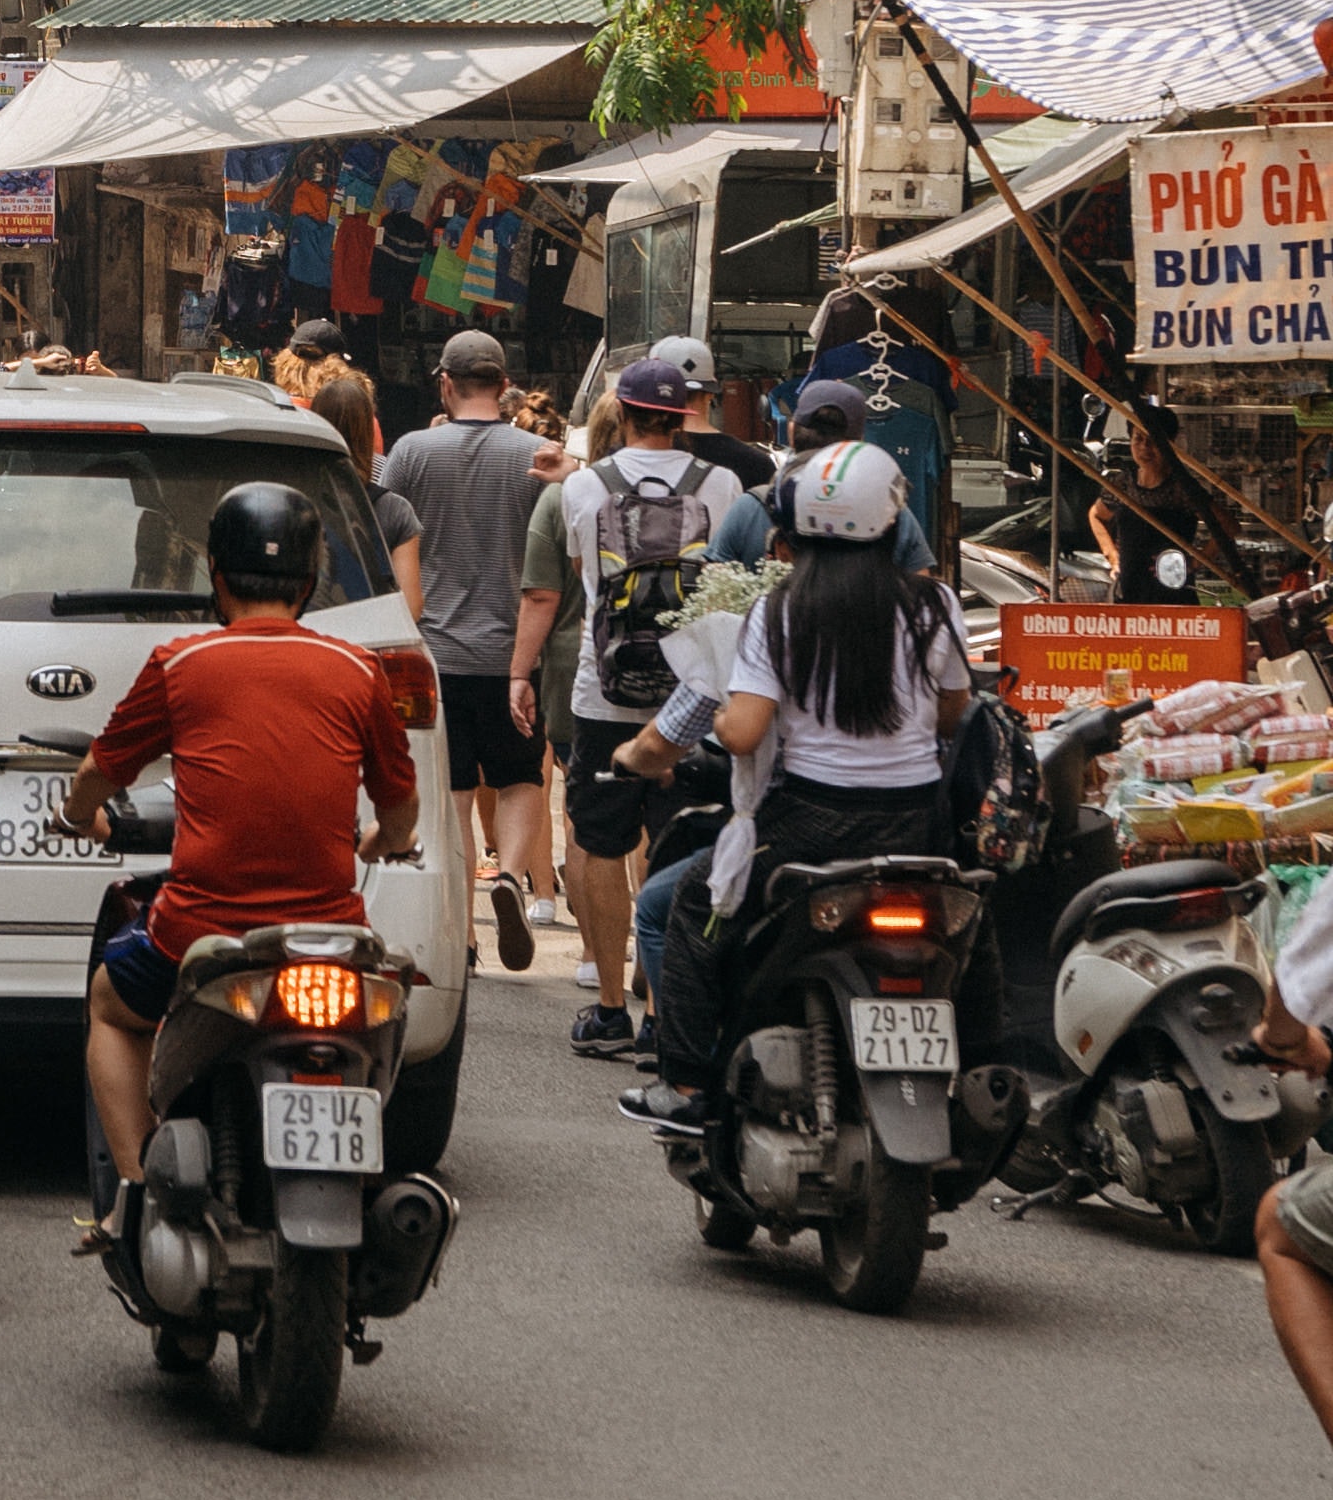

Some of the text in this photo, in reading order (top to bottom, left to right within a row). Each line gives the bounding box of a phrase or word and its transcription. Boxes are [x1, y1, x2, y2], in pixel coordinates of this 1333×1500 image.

[750, 69, 787, 88] Đinh
[1148, 139, 1328, 234] PHỞ GÀ
[1153, 238, 1263, 289] BÚN
[1151, 283, 1332, 350] BÚN CHẢ
[1022, 613, 1070, 634] UBND
[1073, 612, 1121, 638] QUẬN
[1125, 613, 1172, 637] HOÀN
[1046, 646, 1102, 672] TUYẾN
[1106, 647, 1143, 672] PHỐ
[38, 671, 86, 694] KIA
[22, 776, 76, 814] 30
[869, 1005, 940, 1034] 29-D2
[864, 1036, 950, 1066] 211.27
[282, 1093, 363, 1128] 29-U4
[283, 1130, 364, 1163] 6218
